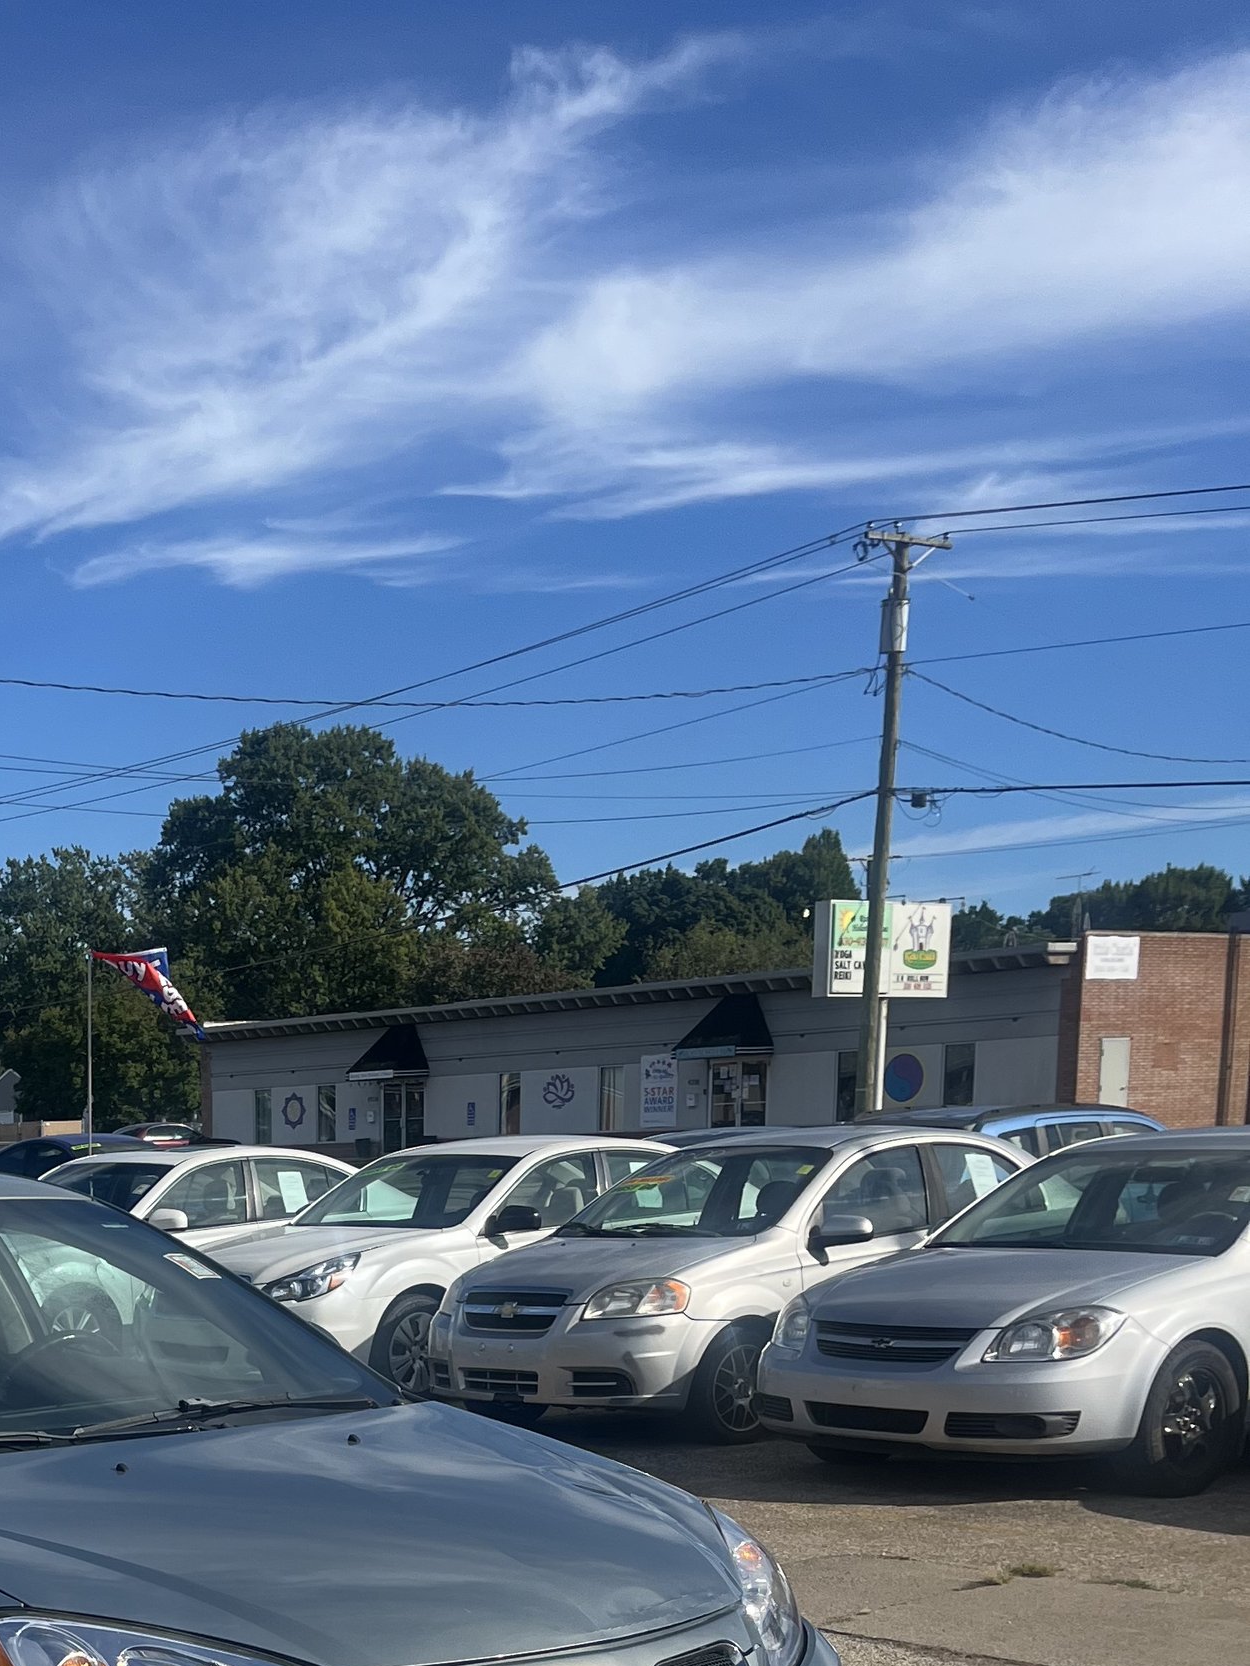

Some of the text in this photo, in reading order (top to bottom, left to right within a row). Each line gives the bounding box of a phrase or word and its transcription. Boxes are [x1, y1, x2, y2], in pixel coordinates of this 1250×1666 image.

[834, 950, 852, 959] YOGA
[834, 960, 851, 970] SALT
[833, 970, 852, 980] REIKI
[643, 1096, 675, 1106] AWARD
